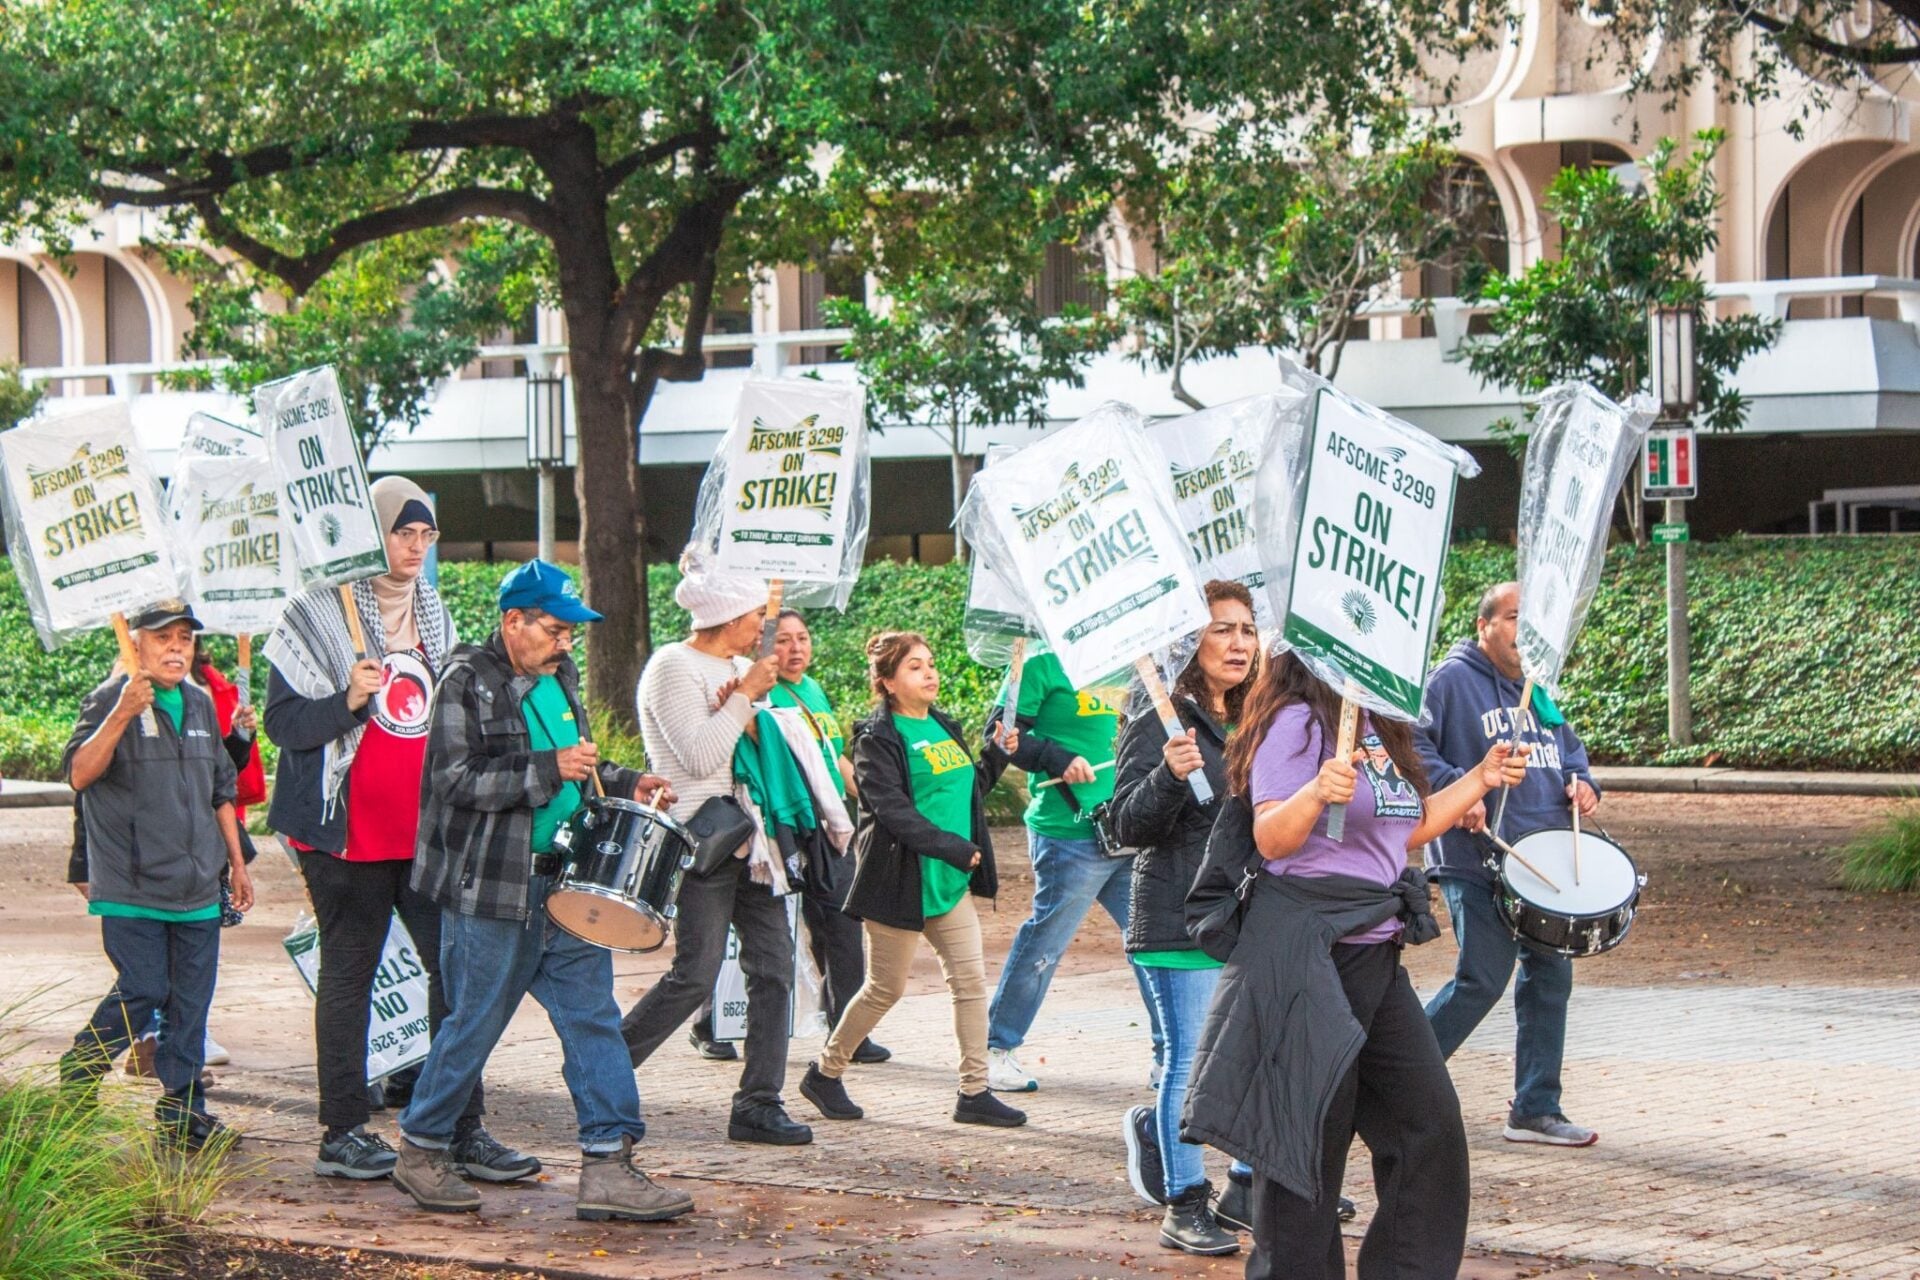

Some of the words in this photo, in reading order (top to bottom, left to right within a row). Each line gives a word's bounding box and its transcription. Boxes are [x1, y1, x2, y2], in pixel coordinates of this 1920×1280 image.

[299, 435, 325, 470] ON
[750, 430, 805, 451] AFSCME
[809, 426, 844, 446] 3299
[32, 461, 88, 499] AFSCME
[782, 452, 805, 472] ON
[1174, 459, 1227, 500] AFSCME
[1326, 431, 1389, 485] AFSCME
[1393, 468, 1436, 510] 3299
[72, 483, 97, 508] ON
[202, 495, 246, 522] AFSCME
[286, 464, 364, 525] STRIKE!
[741, 472, 838, 511] STRIKE!
[1022, 488, 1081, 542] AFSCME
[1079, 458, 1121, 498] 3299
[1211, 484, 1237, 513] ON
[45, 491, 142, 558] STRIKE!
[231, 519, 250, 537] ON
[1068, 509, 1096, 542] ON
[1354, 491, 1393, 546] ON
[203, 531, 280, 574] STRIKE!
[1044, 508, 1151, 607] STRIKE!
[1308, 515, 1426, 632] STRIKE!
[1481, 708, 1509, 739] UC
[371, 946, 423, 993] STR
[371, 991, 409, 1022] ON
[722, 1000, 748, 1017] 3299
